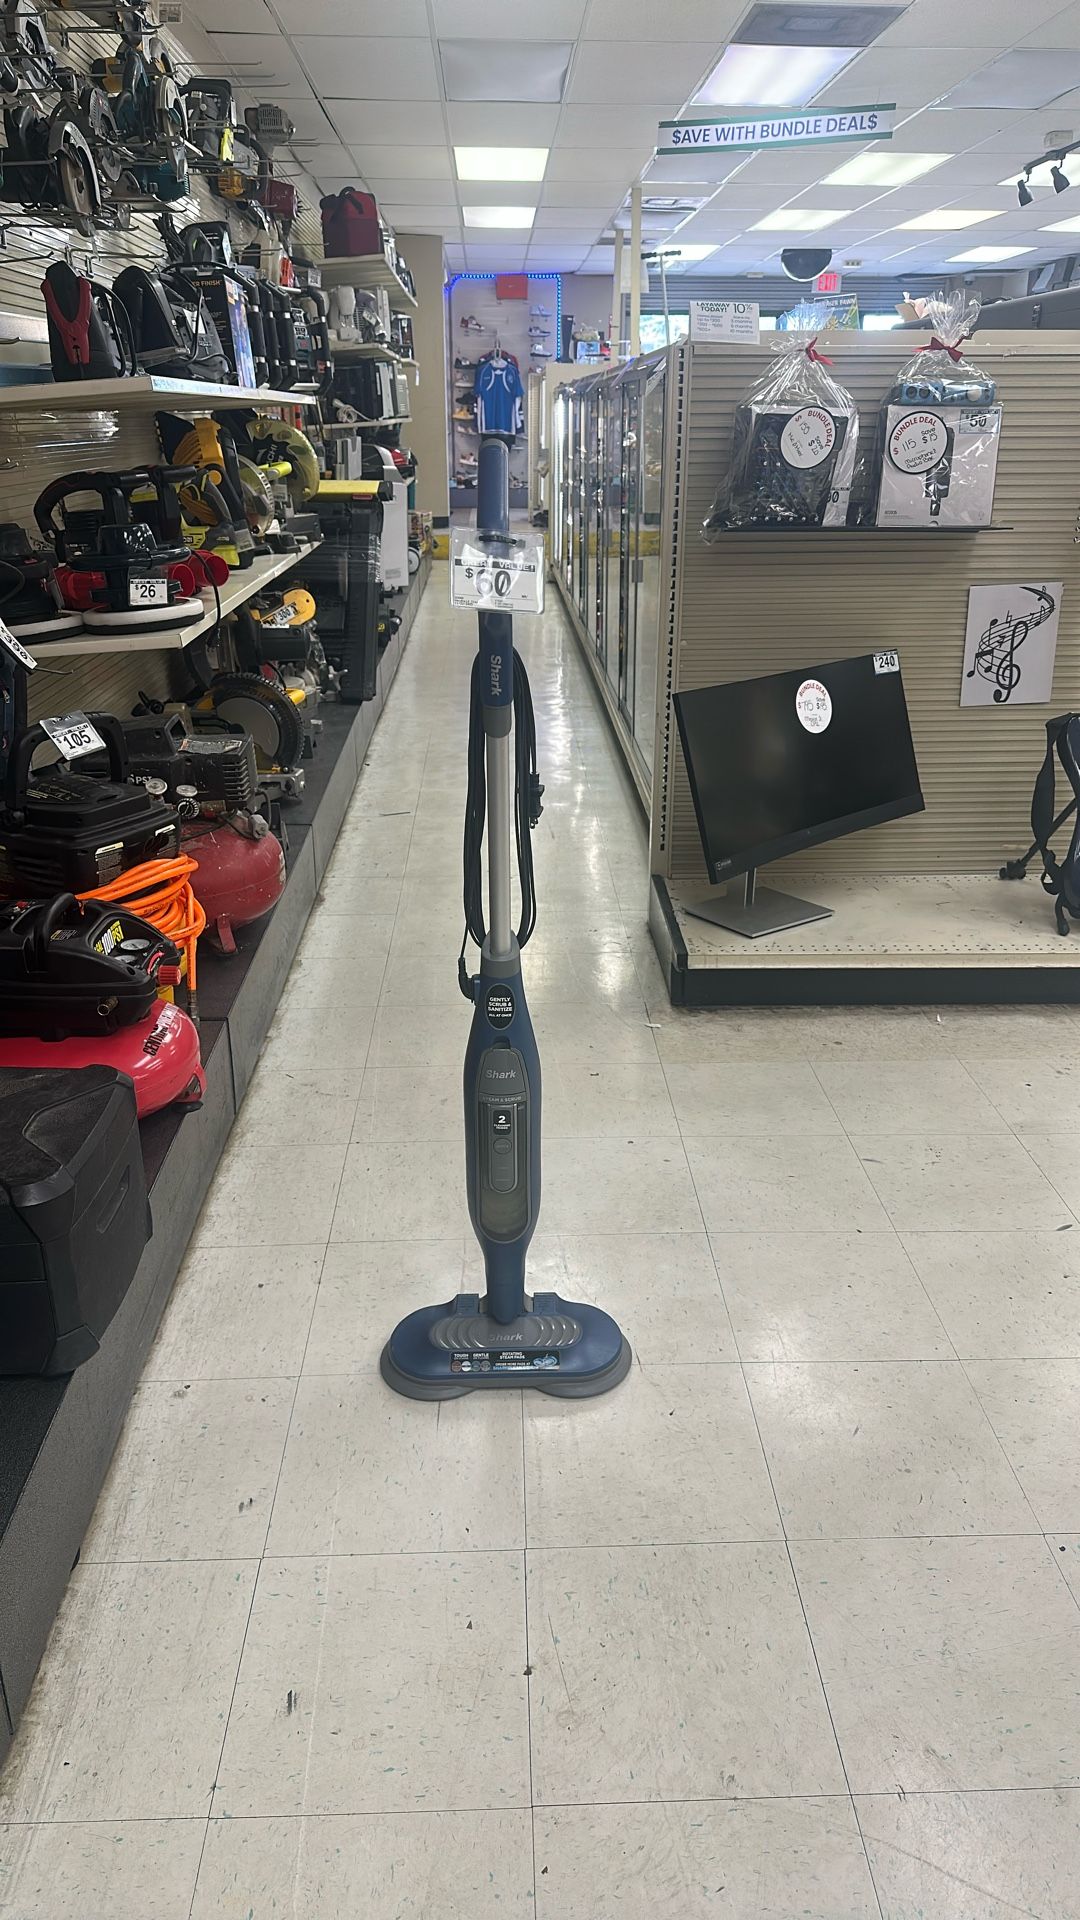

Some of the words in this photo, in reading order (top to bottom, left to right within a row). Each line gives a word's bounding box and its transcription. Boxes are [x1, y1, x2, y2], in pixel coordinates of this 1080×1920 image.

[672, 129, 711, 146] $AVE
[715, 124, 755, 142] WITH
[760, 119, 821, 139] BUNDLE
[826, 113, 878, 134] DEAL$
[817, 273, 838, 291] EXIT
[733, 303, 753, 314] 10%
[807, 410, 831, 429] BUNDLE
[825, 428, 833, 448] DEAL
[894, 417, 918, 441] BUNDLE
[919, 416, 937, 427] DEAL
[902, 438, 917, 452] 115
[499, 561, 534, 572] VALUE!
[490, 654, 502, 696] Shark
[799, 682, 815, 697] BUNDLE
[815, 684, 827, 697] DEAL
[102, 928, 115, 956] 100
[112, 925, 124, 946] PSI
[486, 1069, 517, 1079] Shark
[498, 1115, 506, 1124] 2
[490, 1333, 523, 1341] Shark
